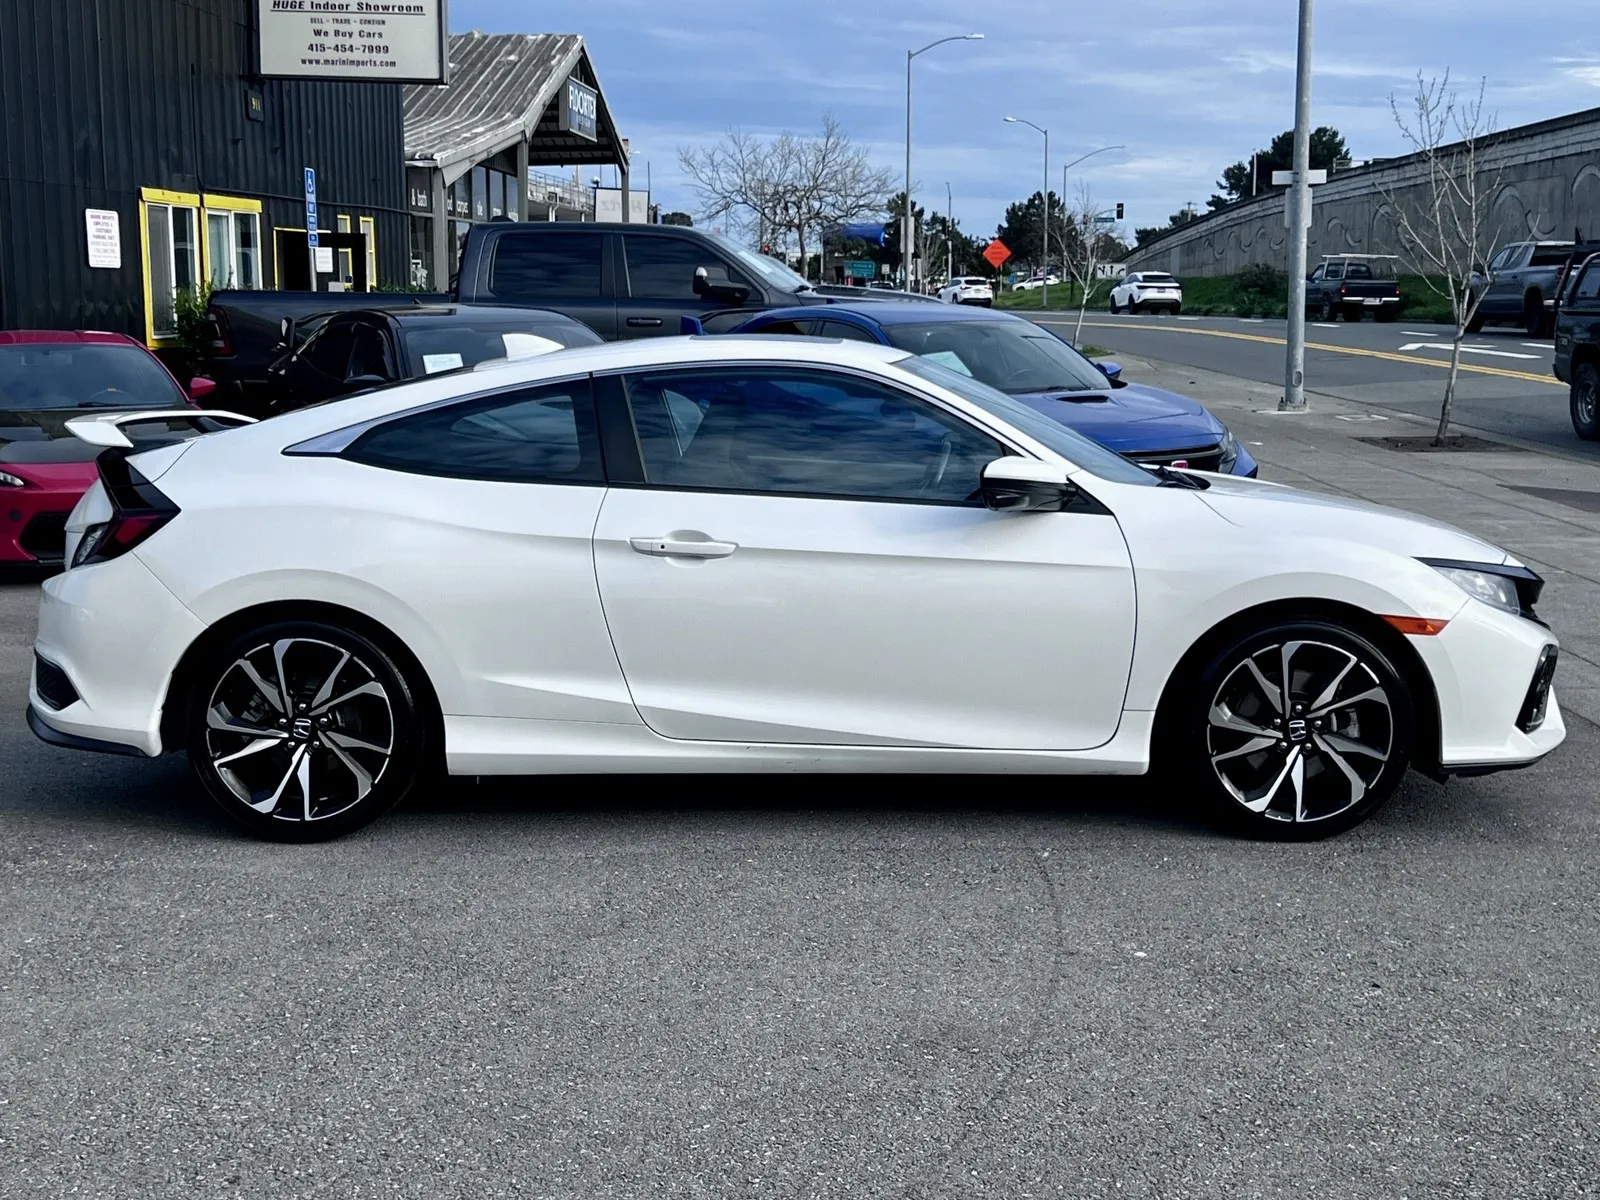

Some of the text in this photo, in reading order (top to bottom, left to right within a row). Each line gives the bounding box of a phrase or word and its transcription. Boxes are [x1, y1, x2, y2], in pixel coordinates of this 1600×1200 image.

[272, 0, 424, 13] HUGE Indoor Showroom
[313, 28, 384, 39] We Buy Cars
[307, 43, 390, 54] 415-454-7999
[300, 58, 397, 68] www.marinimports.com
[251, 96, 261, 112] 911
